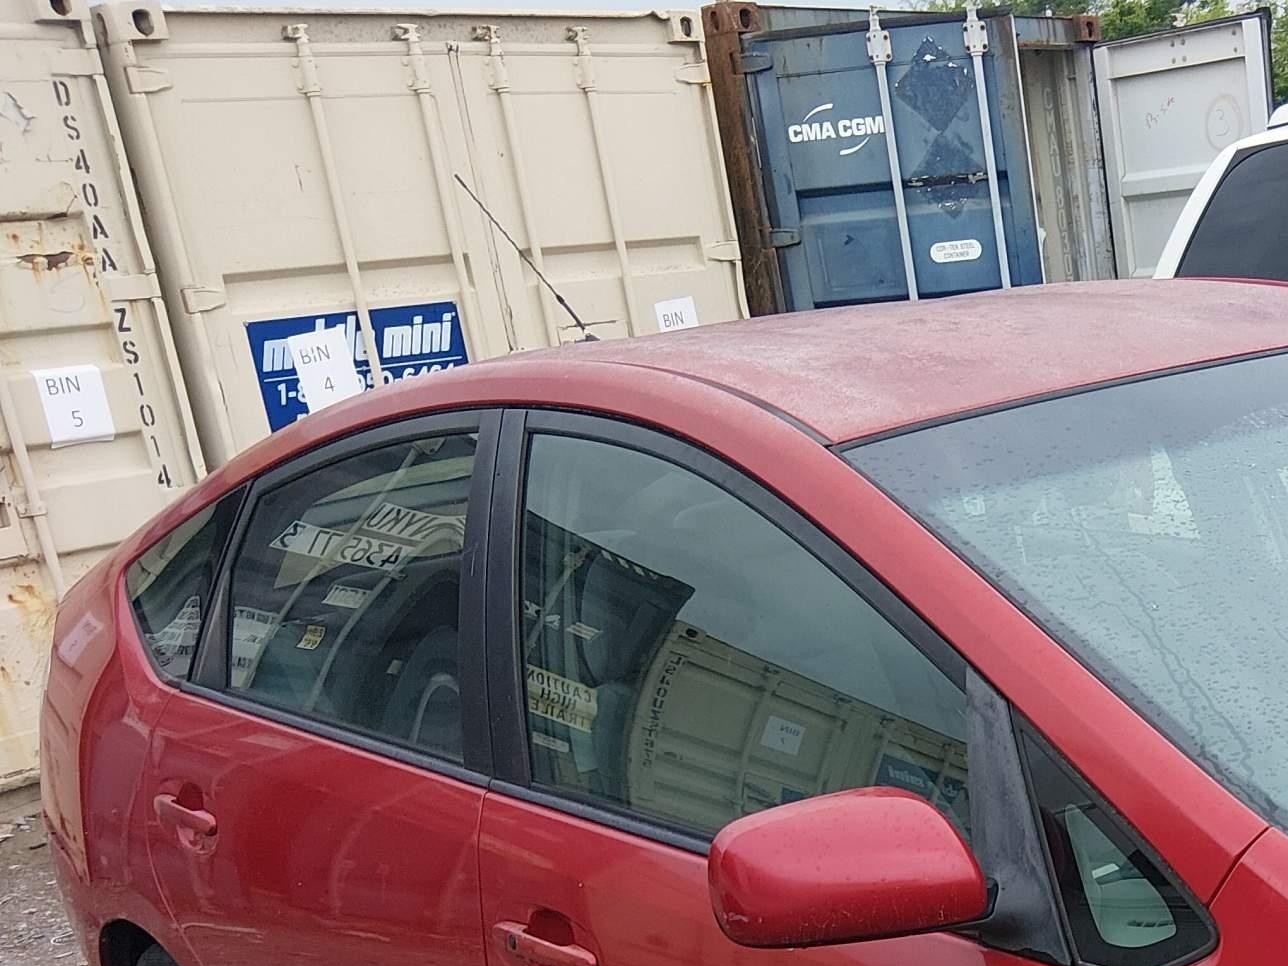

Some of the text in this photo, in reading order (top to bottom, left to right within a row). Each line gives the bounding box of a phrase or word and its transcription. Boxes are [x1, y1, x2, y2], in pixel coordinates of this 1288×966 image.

[788, 115, 885, 143] CMA CGM
[662, 310, 685, 328] BIN
[382, 313, 453, 359] mini
[299, 344, 331, 366] BIN
[45, 375, 82, 397] BIN
[323, 375, 336, 393] 4
[71, 410, 85, 428] 5
